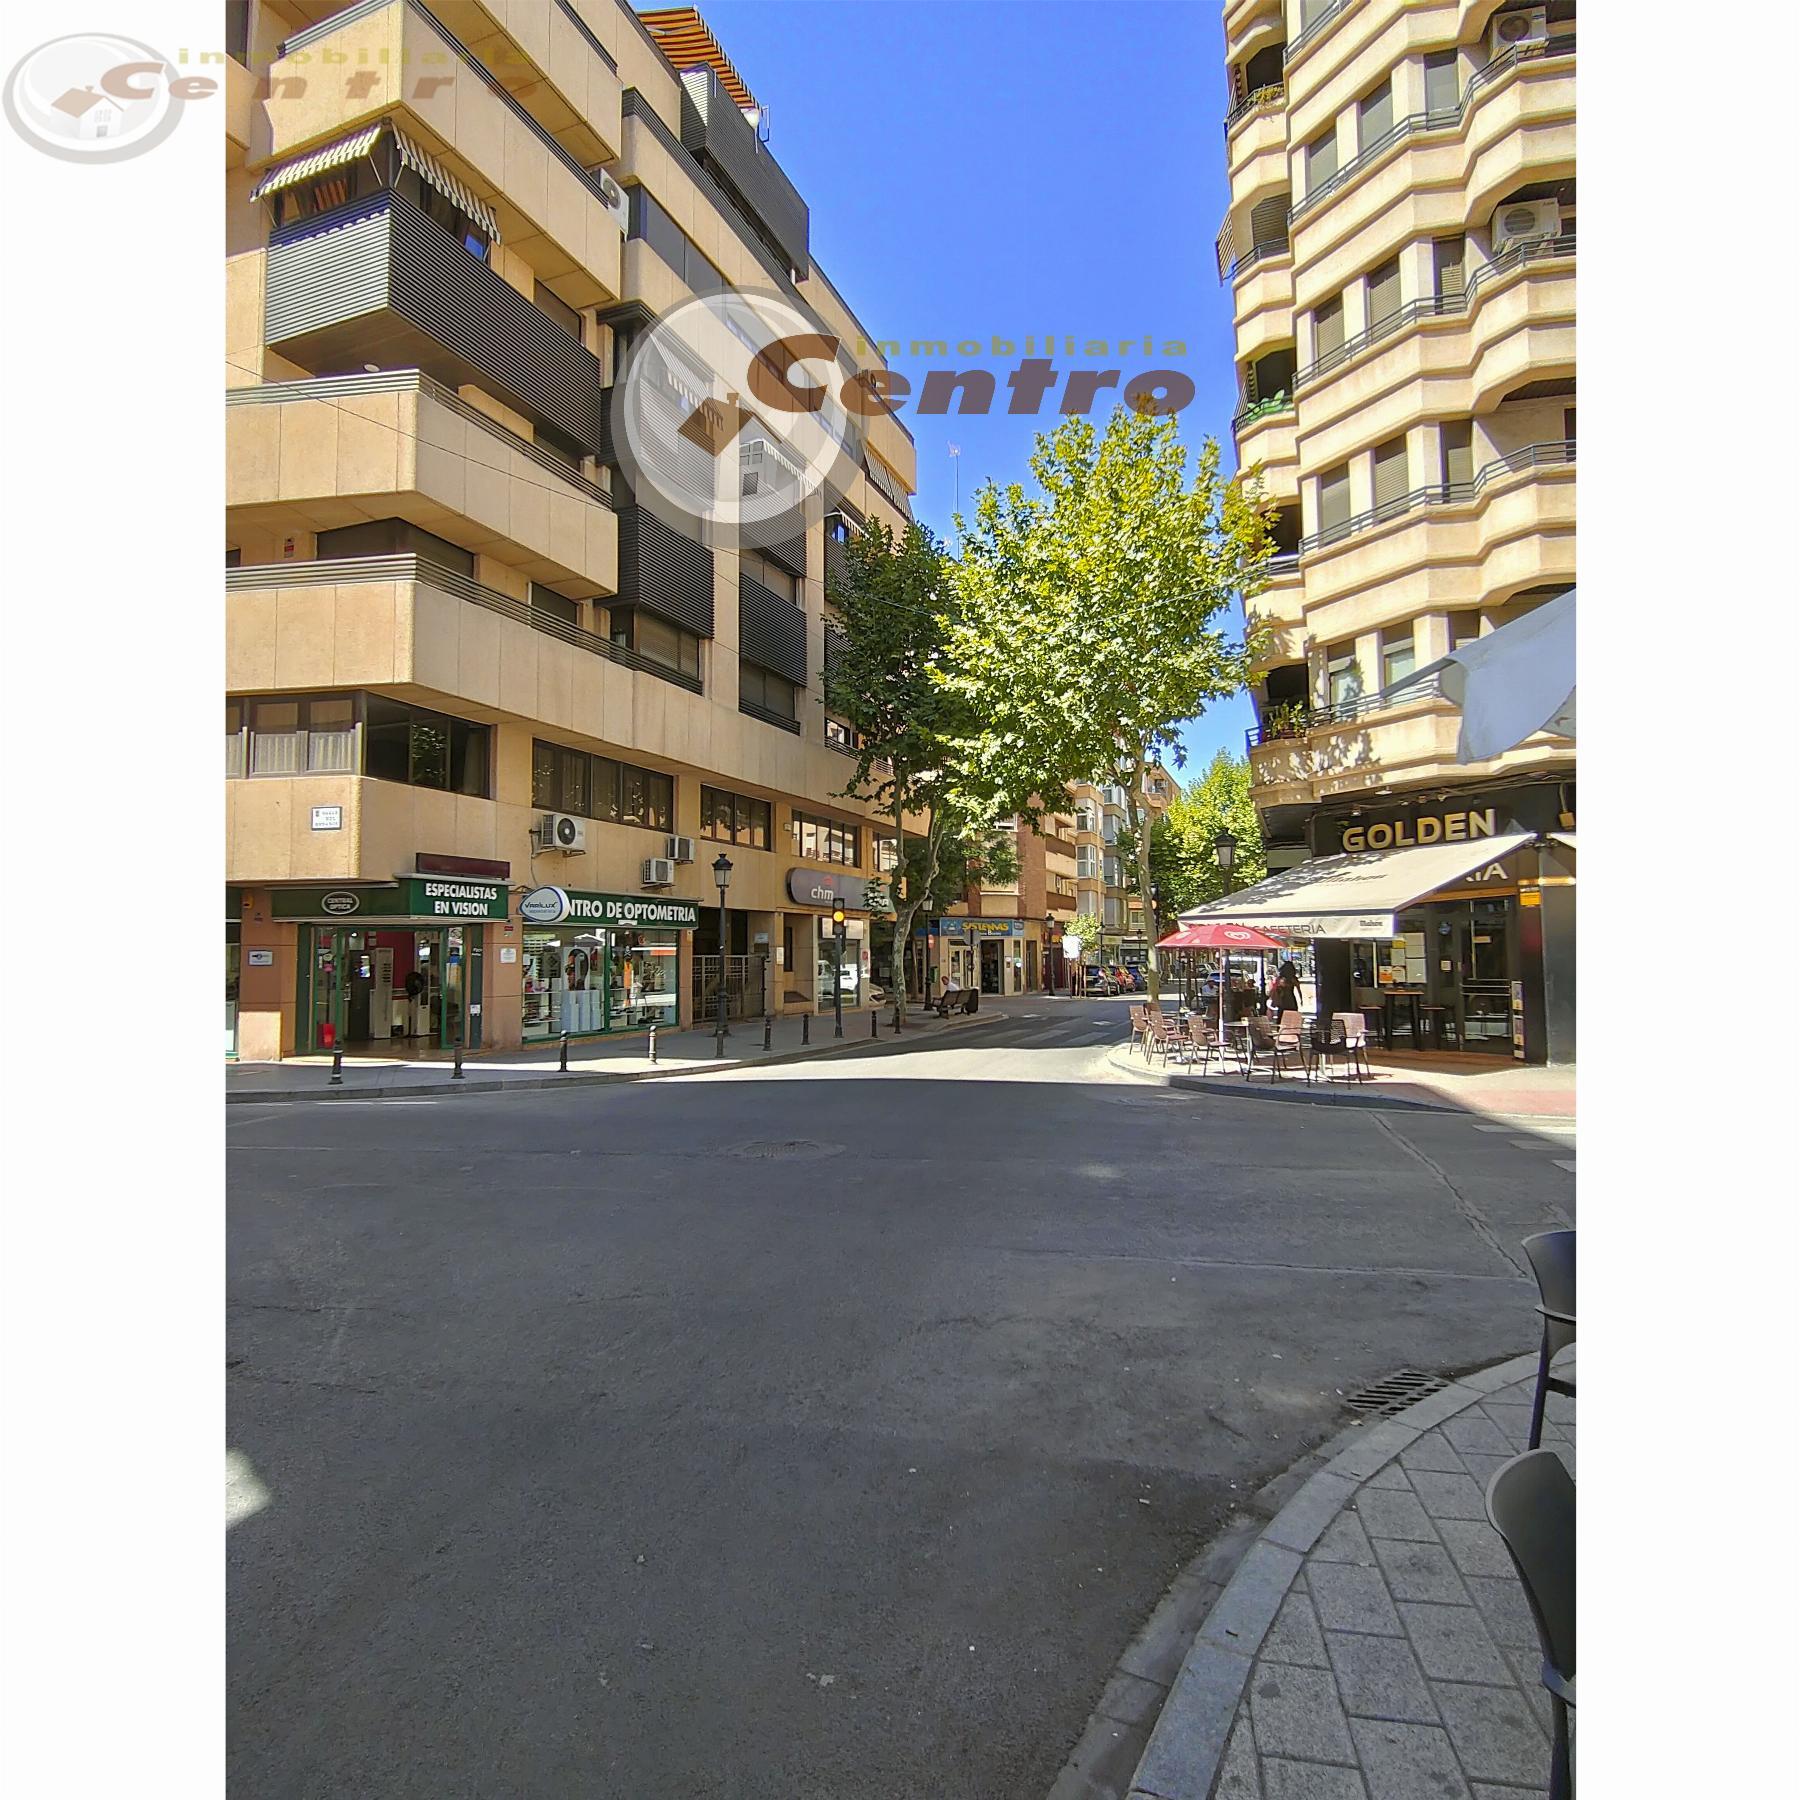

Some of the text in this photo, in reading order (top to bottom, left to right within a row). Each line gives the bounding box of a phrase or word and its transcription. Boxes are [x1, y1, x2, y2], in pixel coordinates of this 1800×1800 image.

[1342, 808, 1496, 852] GOLDEN
[425, 882, 498, 900] ESPECIALISTAS
[811, 884, 834, 900] chm
[434, 901, 489, 916] EN VISION
[606, 902, 622, 918] DE
[623, 902, 697, 922] OPTOMETRIA
